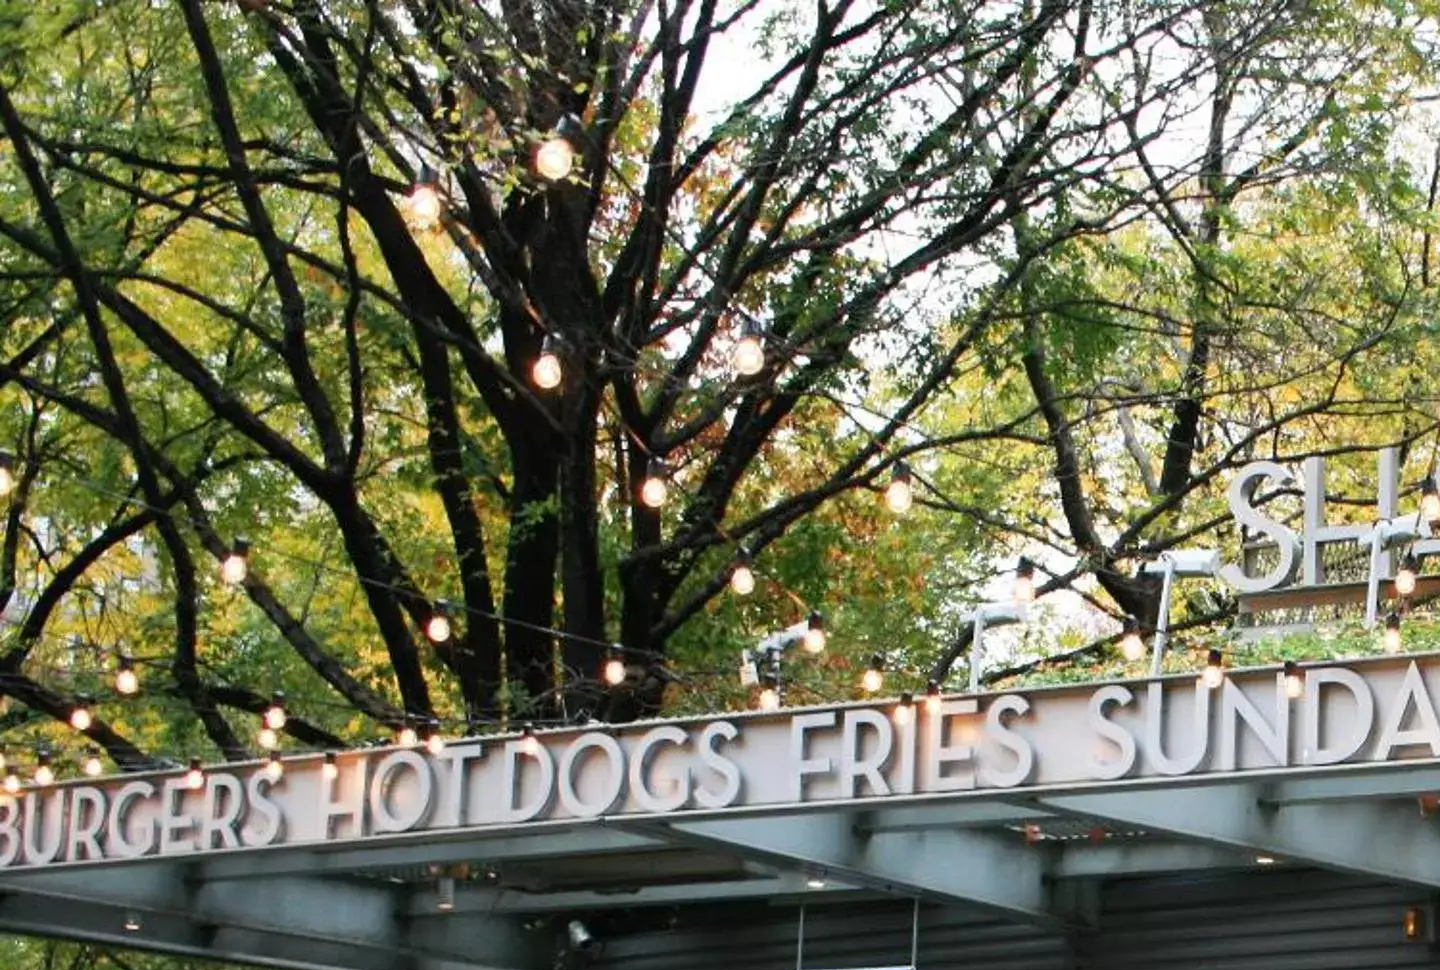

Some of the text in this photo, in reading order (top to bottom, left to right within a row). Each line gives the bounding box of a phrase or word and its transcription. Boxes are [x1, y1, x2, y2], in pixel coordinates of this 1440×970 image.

[316, 741, 482, 841] HOT
[501, 718, 741, 824] DOGS
[790, 693, 1039, 801] FRIES
